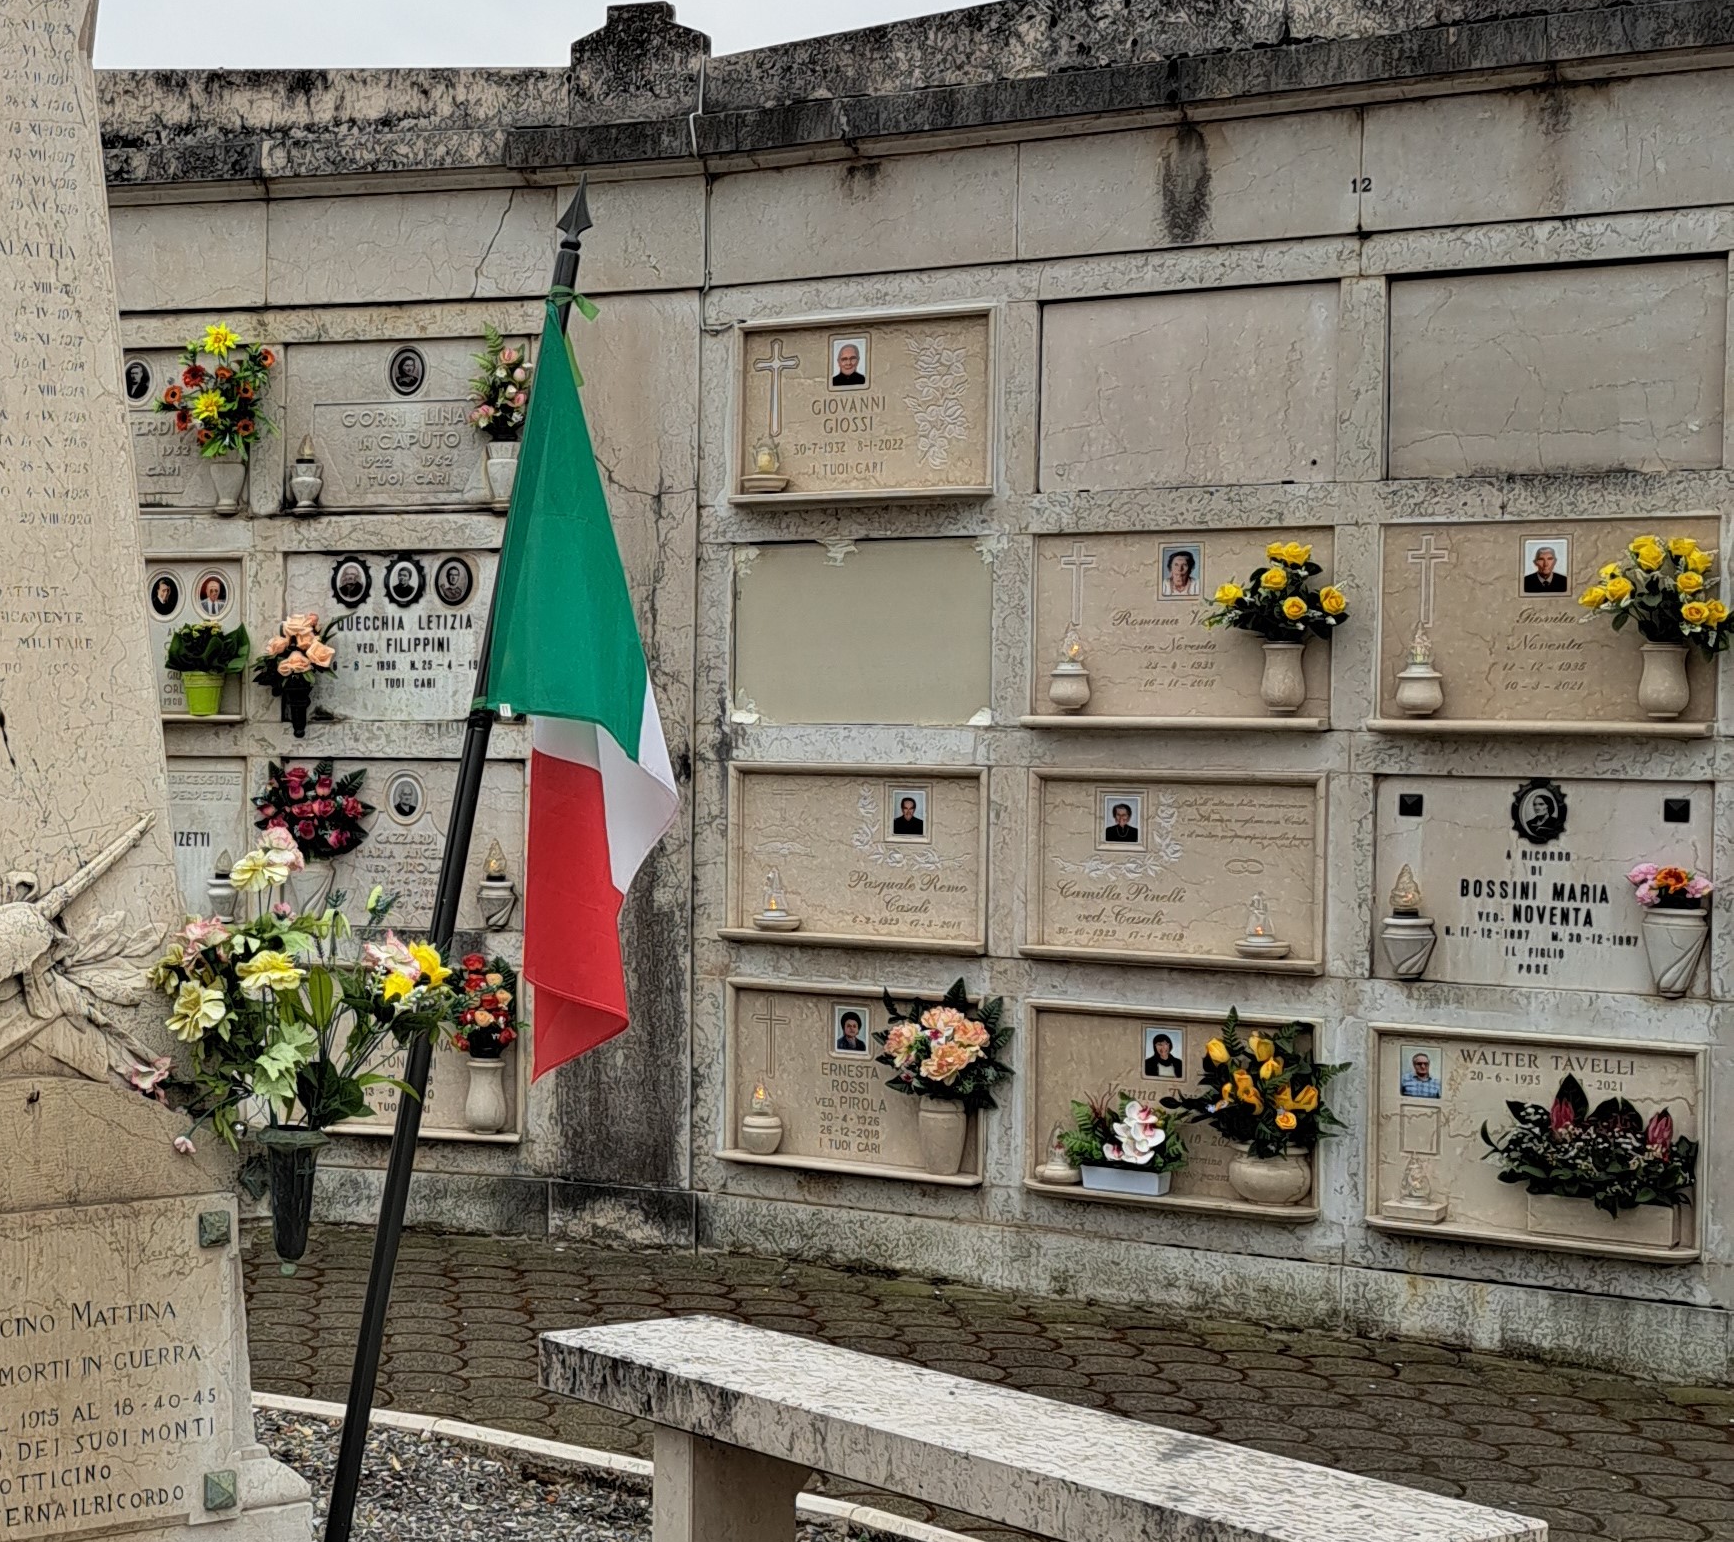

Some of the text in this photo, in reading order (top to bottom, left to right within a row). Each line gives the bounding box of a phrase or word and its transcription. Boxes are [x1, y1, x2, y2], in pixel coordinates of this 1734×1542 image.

[1351, 177, 1372, 194] 12
[811, 396, 886, 416] GIOVANNI
[342, 407, 467, 428] GORNI LINA
[823, 416, 873, 434] GIOSSI
[377, 431, 461, 451] CAPUTO
[793, 439, 904, 455] 30-7-1932 8-1-2022
[362, 455, 453, 469] 1922 1962
[822, 462, 884, 475] TUOI CARI
[368, 472, 451, 486] TUOI CARI
[337, 614, 473, 631] QUECCHIA LETIZIA
[356, 637, 450, 654] VED. FILIPPINI
[1506, 634, 1583, 651] Noventa
[385, 678, 436, 688] TUOI CARI
[1505, 850, 1571, 862] A RICORDO
[1531, 866, 1543, 876] DI
[847, 870, 968, 895] Pasquale Remo
[1056, 879, 1186, 903] Camilla Pinelli
[1460, 879, 1610, 904] BOSSINI MARIA
[882, 894, 931, 913] Casali
[1111, 905, 1164, 925] Casali
[1512, 904, 1594, 928] NOVENTA
[1505, 946, 1564, 959] IL FIGLIO
[1518, 964, 1549, 975] POSE
[821, 1062, 879, 1079] ERNESTA
[1460, 1049, 1635, 1075] WALTER TAVELLI
[831, 1079, 869, 1094] ROSSI
[1469, 1070, 1541, 1086] 20-6-1935
[839, 1096, 887, 1112] PIROLA
[819, 1125, 880, 1139] 26-12-2018
[829, 1139, 881, 1154] TUOI CARI
[82, 1355, 102, 1376] IN
[113, 1345, 201, 1371] GUERRA
[21, 1409, 59, 1429] 1915
[72, 1403, 100, 1423] AL
[18, 1437, 60, 1461] DEI
[74, 1427, 127, 1455] SUOI
[141, 1417, 214, 1445] MONTI
